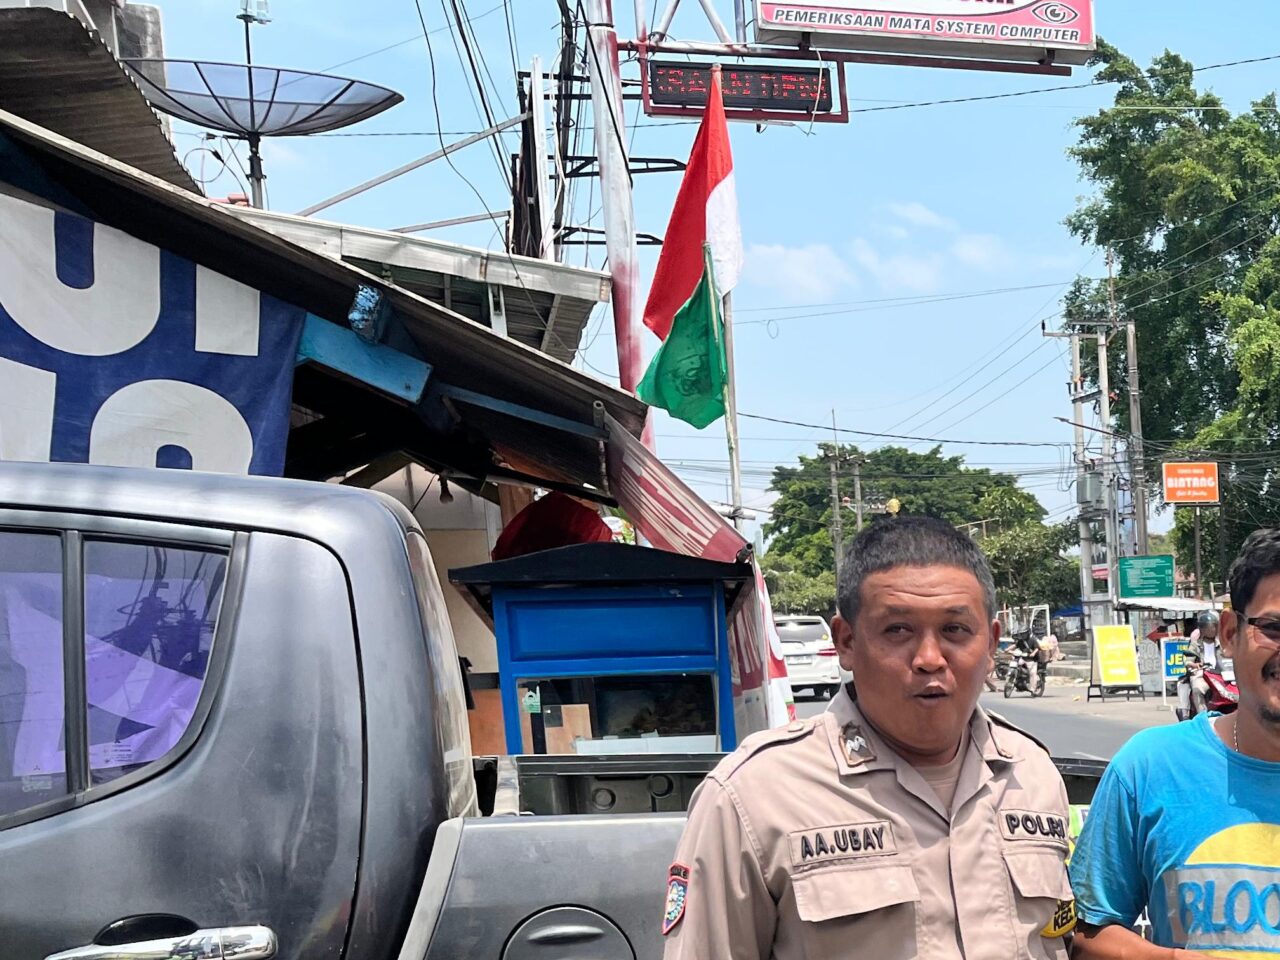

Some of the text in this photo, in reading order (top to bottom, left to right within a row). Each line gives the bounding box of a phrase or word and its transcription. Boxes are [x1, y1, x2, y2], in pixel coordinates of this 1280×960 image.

[774, 9, 1079, 41] PEMERIKSAAN MATA SYSTEM COMPUTER
